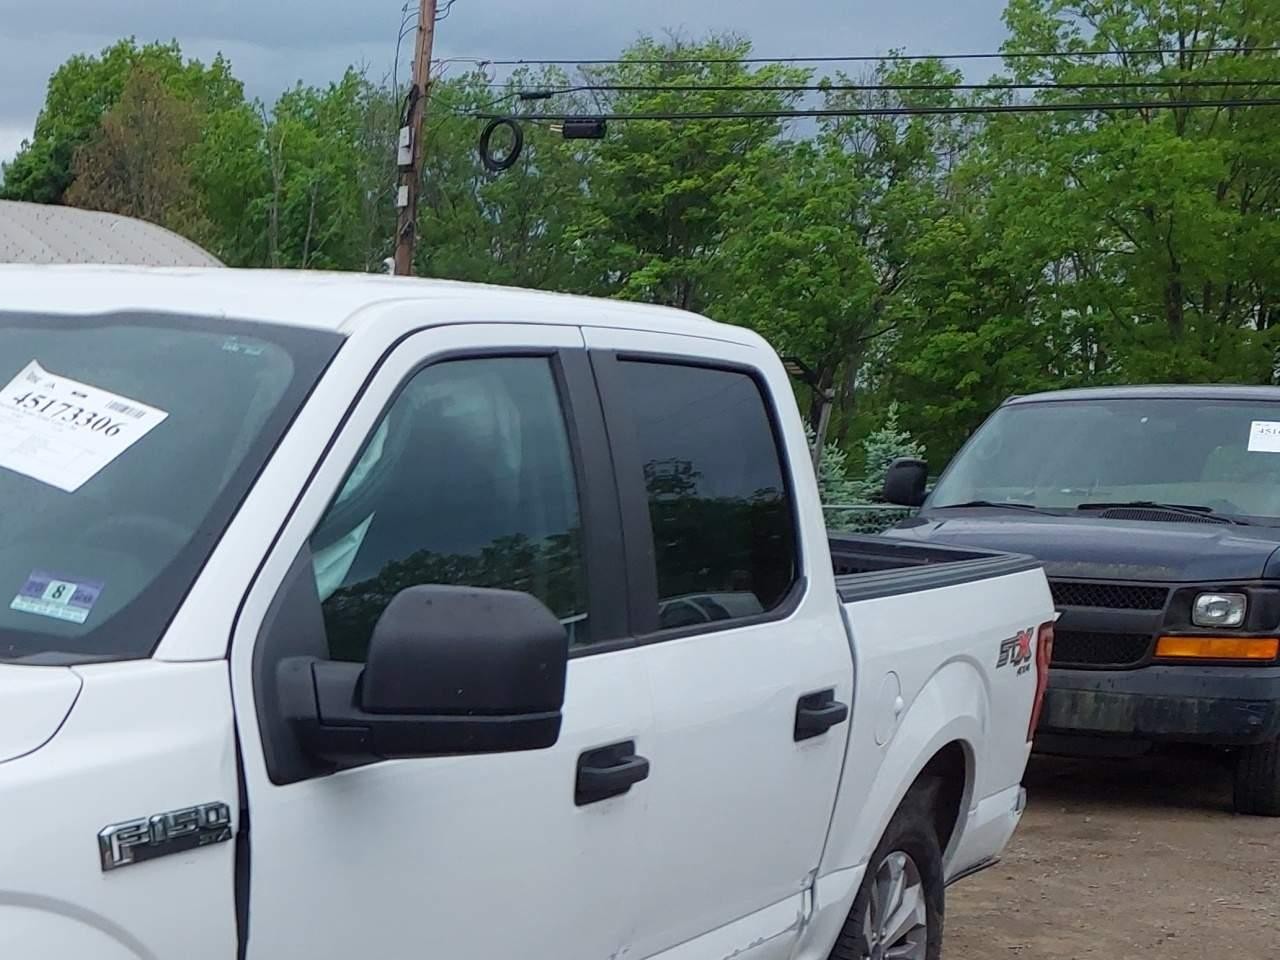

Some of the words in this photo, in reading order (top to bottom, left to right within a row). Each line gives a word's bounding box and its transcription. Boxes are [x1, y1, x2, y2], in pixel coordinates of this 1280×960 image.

[13, 391, 127, 437] 45173306
[51, 584, 66, 599] 8
[996, 627, 1034, 668] STX
